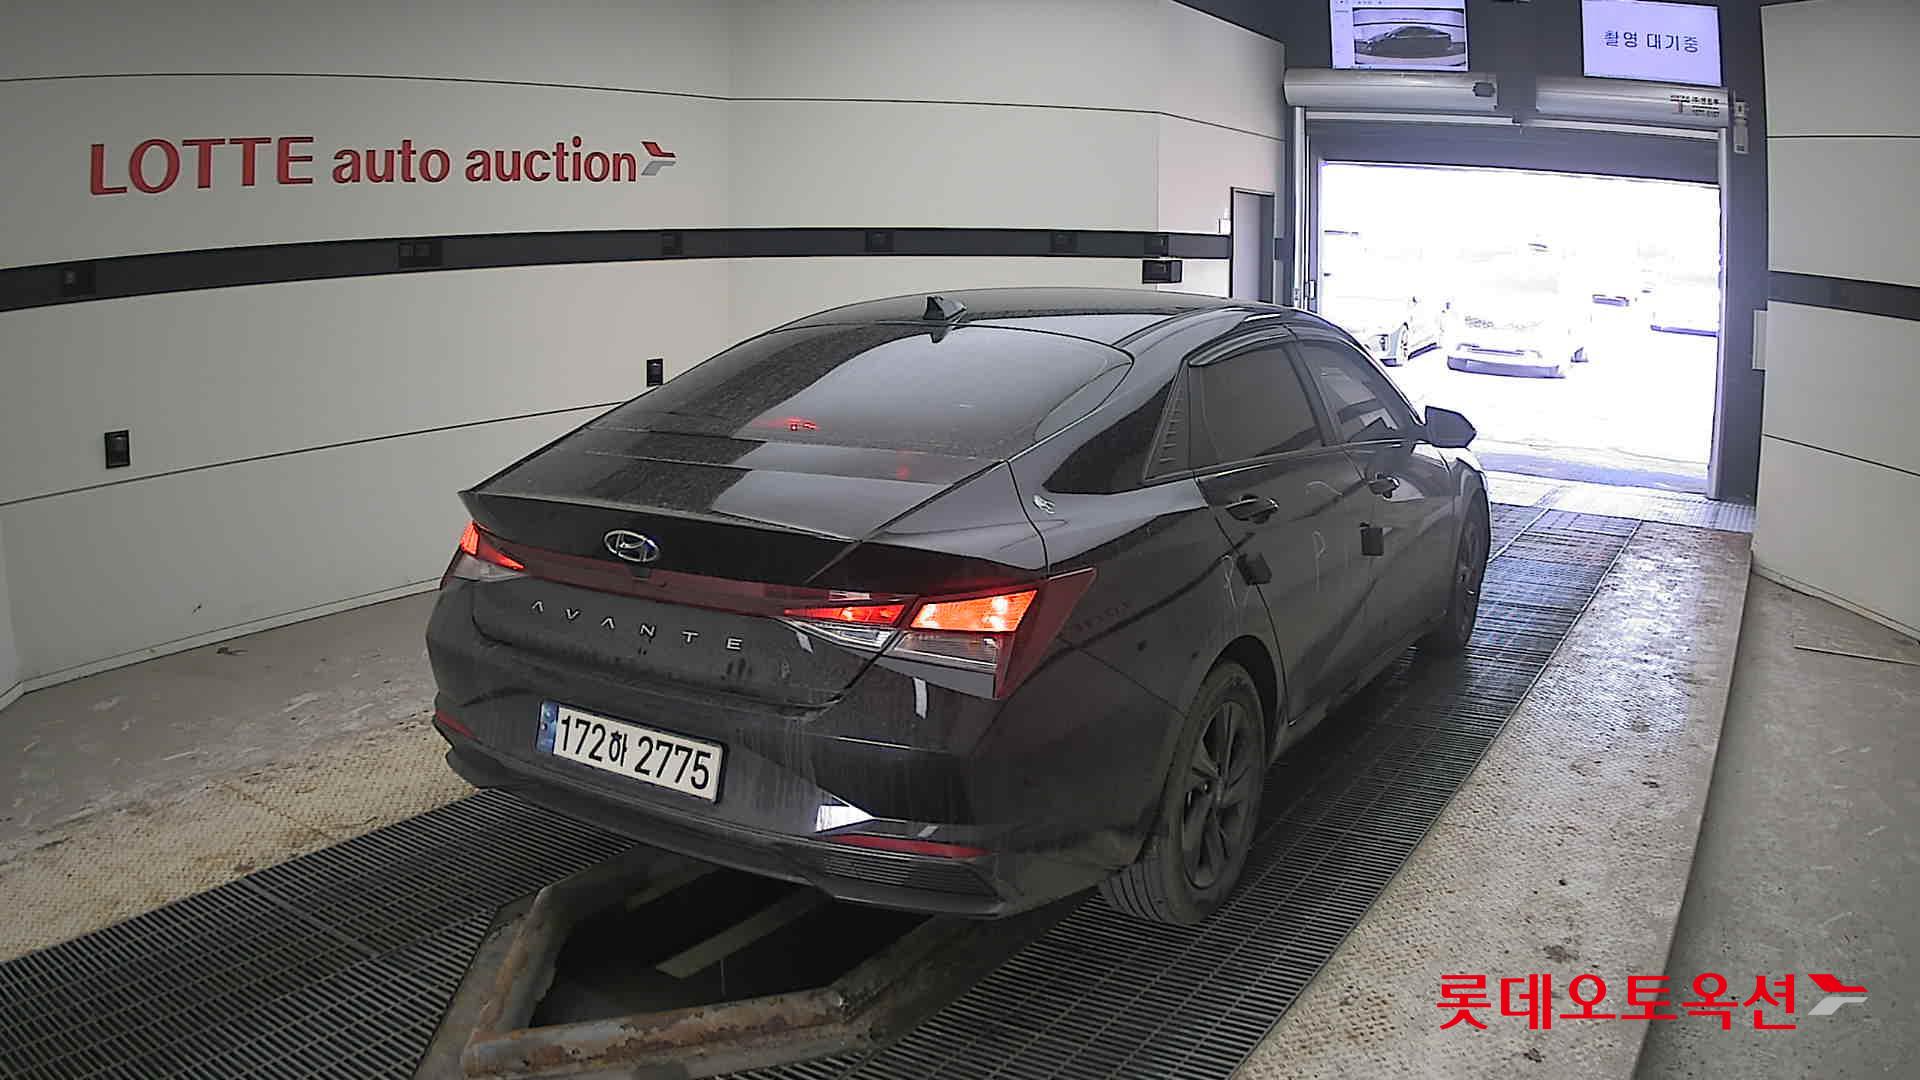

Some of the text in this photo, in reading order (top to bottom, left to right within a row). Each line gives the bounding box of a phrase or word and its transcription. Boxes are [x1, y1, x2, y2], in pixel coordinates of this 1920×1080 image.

[1646, 32, 1699, 53] 대기중
[90, 135, 637, 196] LOTTE auto auction
[531, 598, 743, 651] AVANTE
[561, 714, 712, 790] 172하 2775
